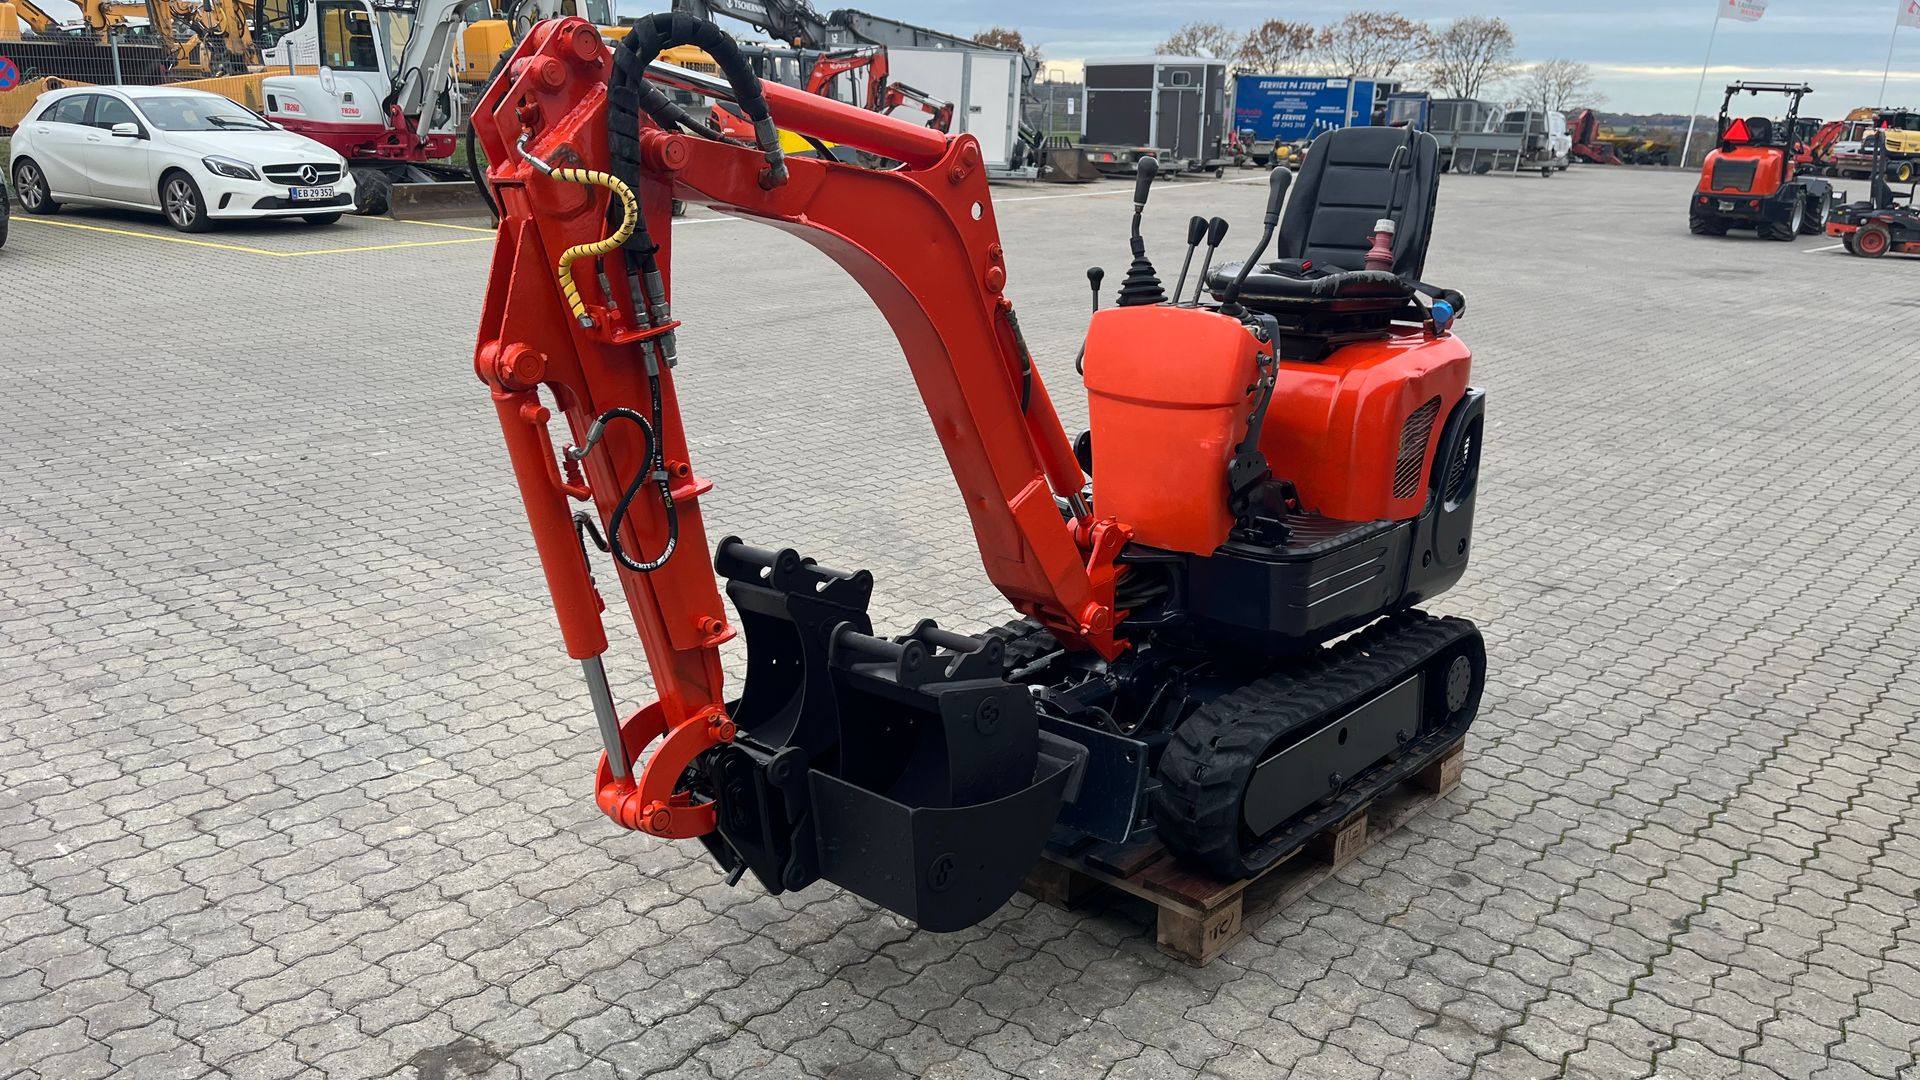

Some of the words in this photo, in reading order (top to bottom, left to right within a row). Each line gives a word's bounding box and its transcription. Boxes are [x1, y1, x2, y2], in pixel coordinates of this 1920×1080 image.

[1259, 81, 1287, 89] SERVICE
[1299, 81, 1326, 90] STEDET
[284, 103, 300, 112] TB260
[298, 189, 309, 198] EB
[310, 189, 319, 197] 29
[320, 188, 333, 197] 352
